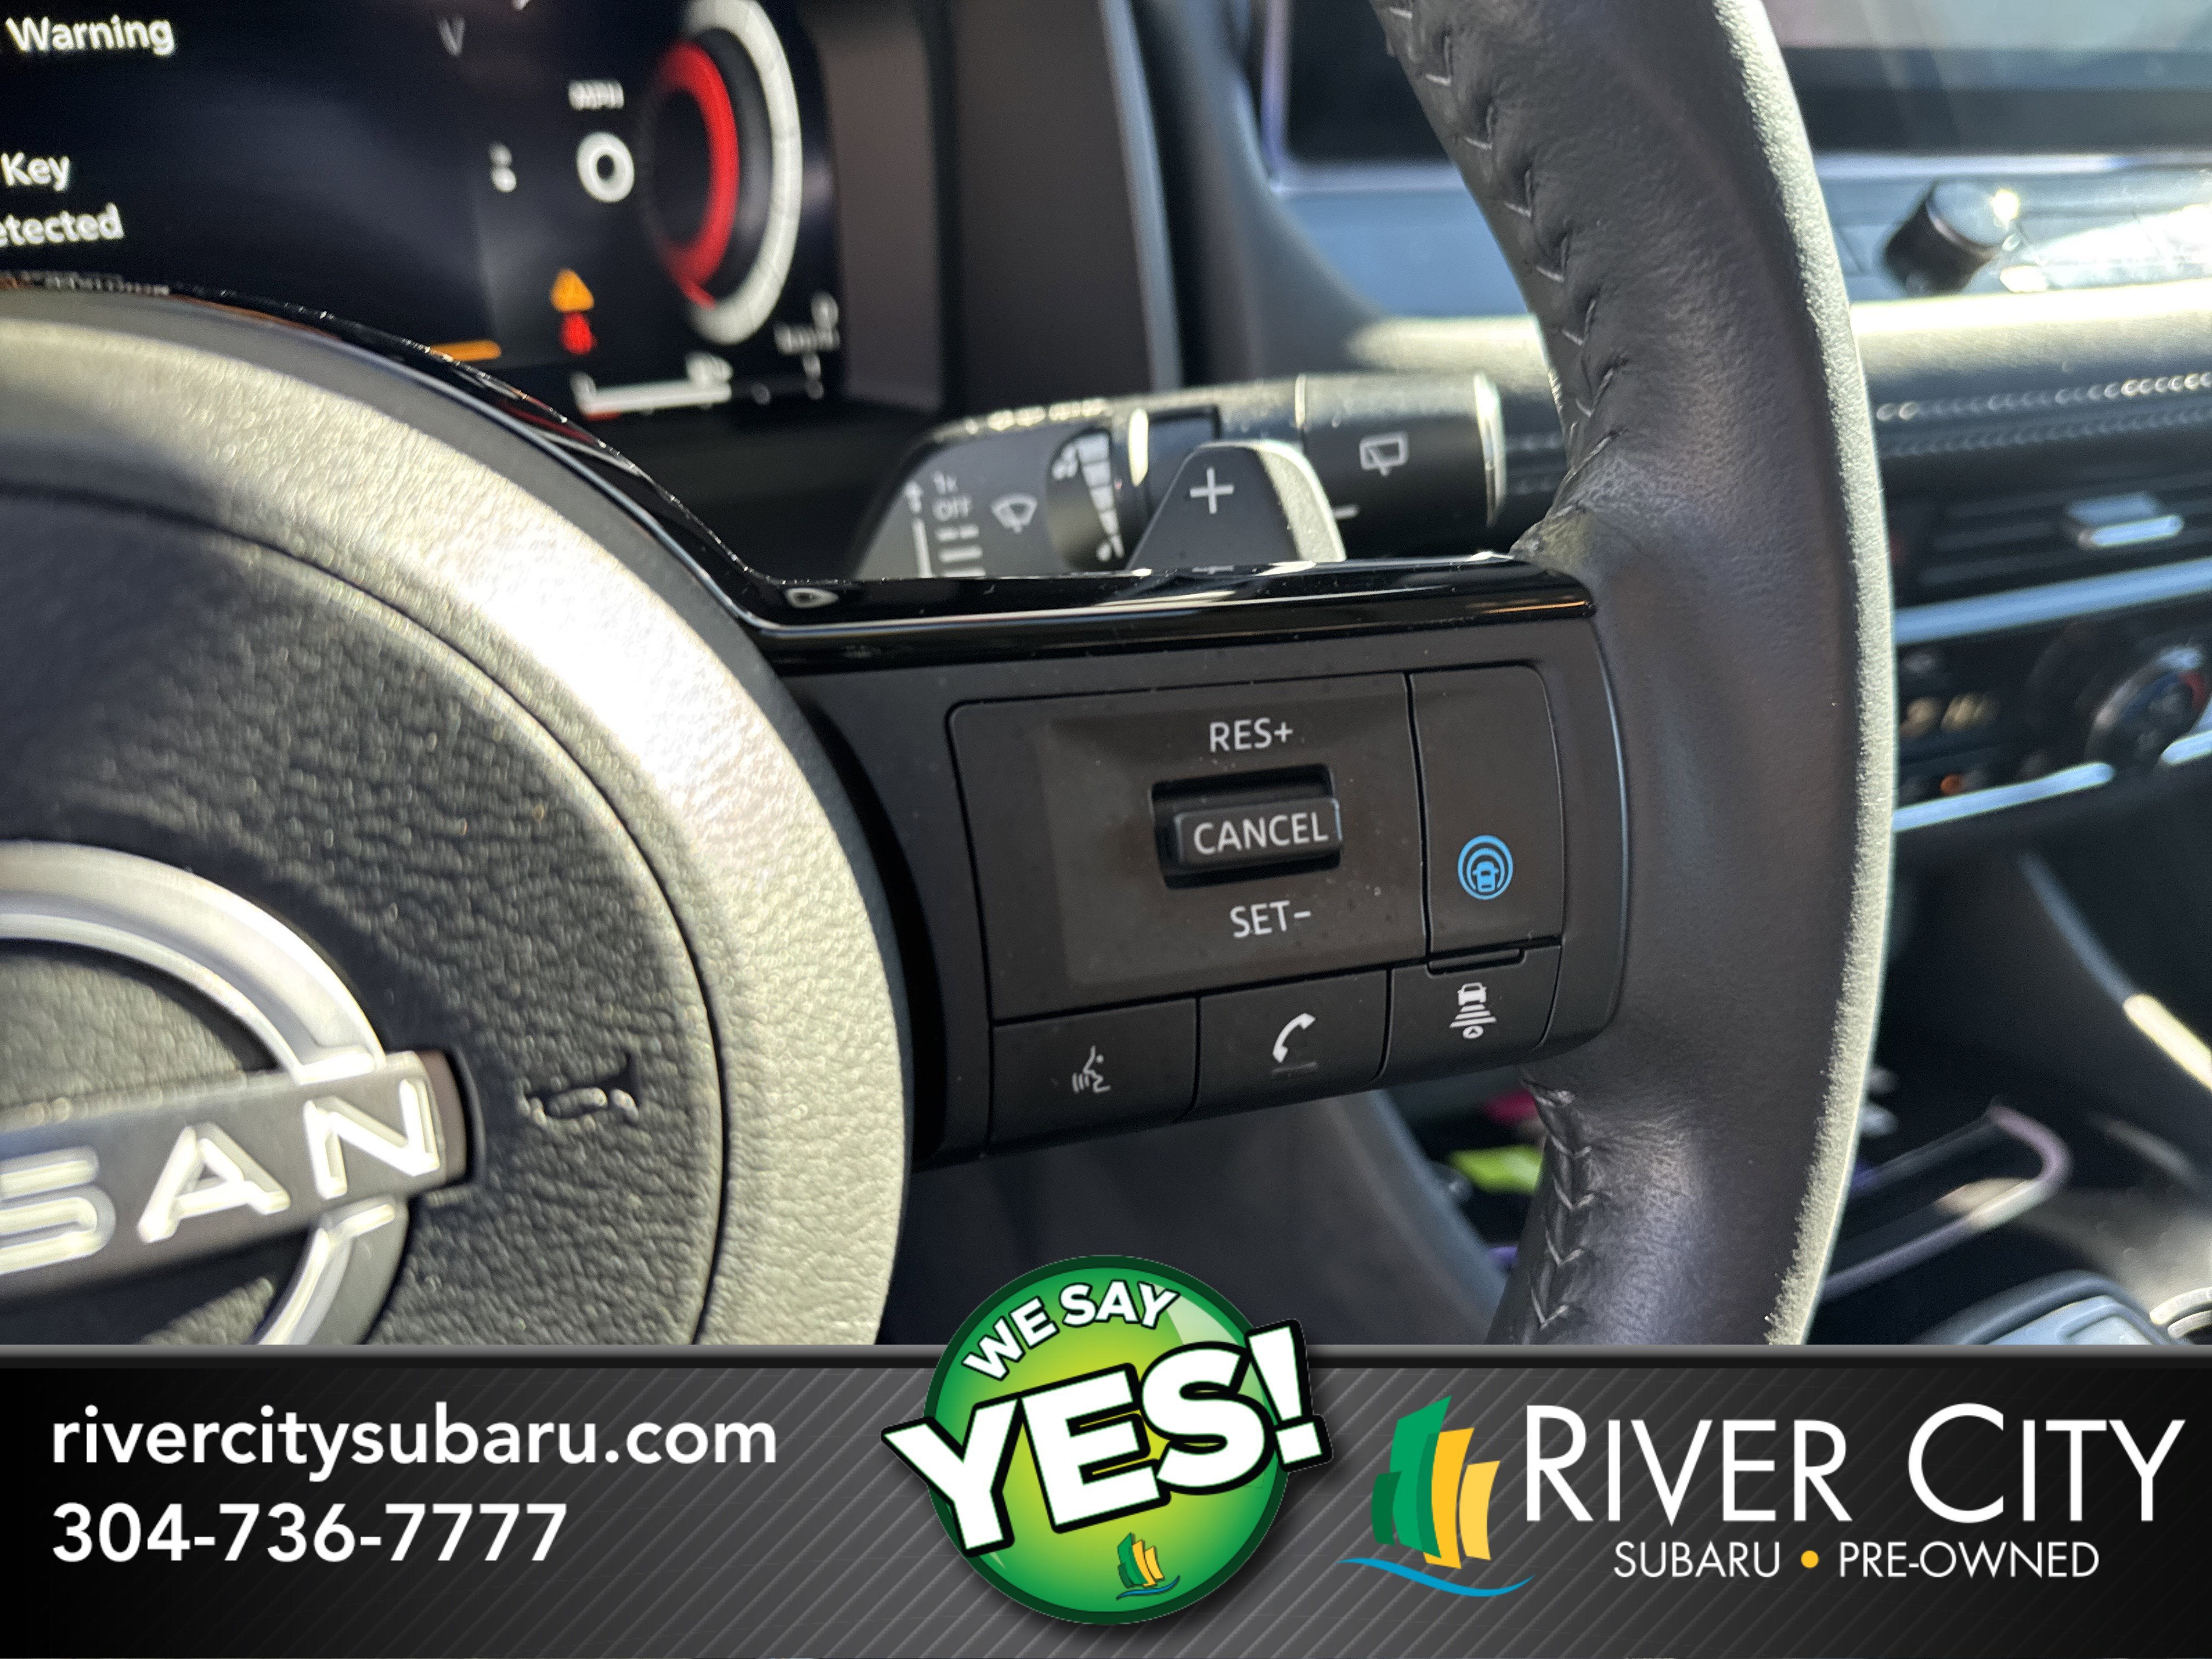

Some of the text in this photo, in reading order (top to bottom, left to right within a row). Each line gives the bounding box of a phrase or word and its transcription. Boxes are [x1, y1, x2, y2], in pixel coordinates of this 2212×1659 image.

[5, 14, 177, 57] Warning
[0, 151, 71, 192] Key
[1209, 716, 1295, 753] RES+
[1193, 811, 1329, 855] CANCEL
[1229, 899, 1312, 939] SET-
